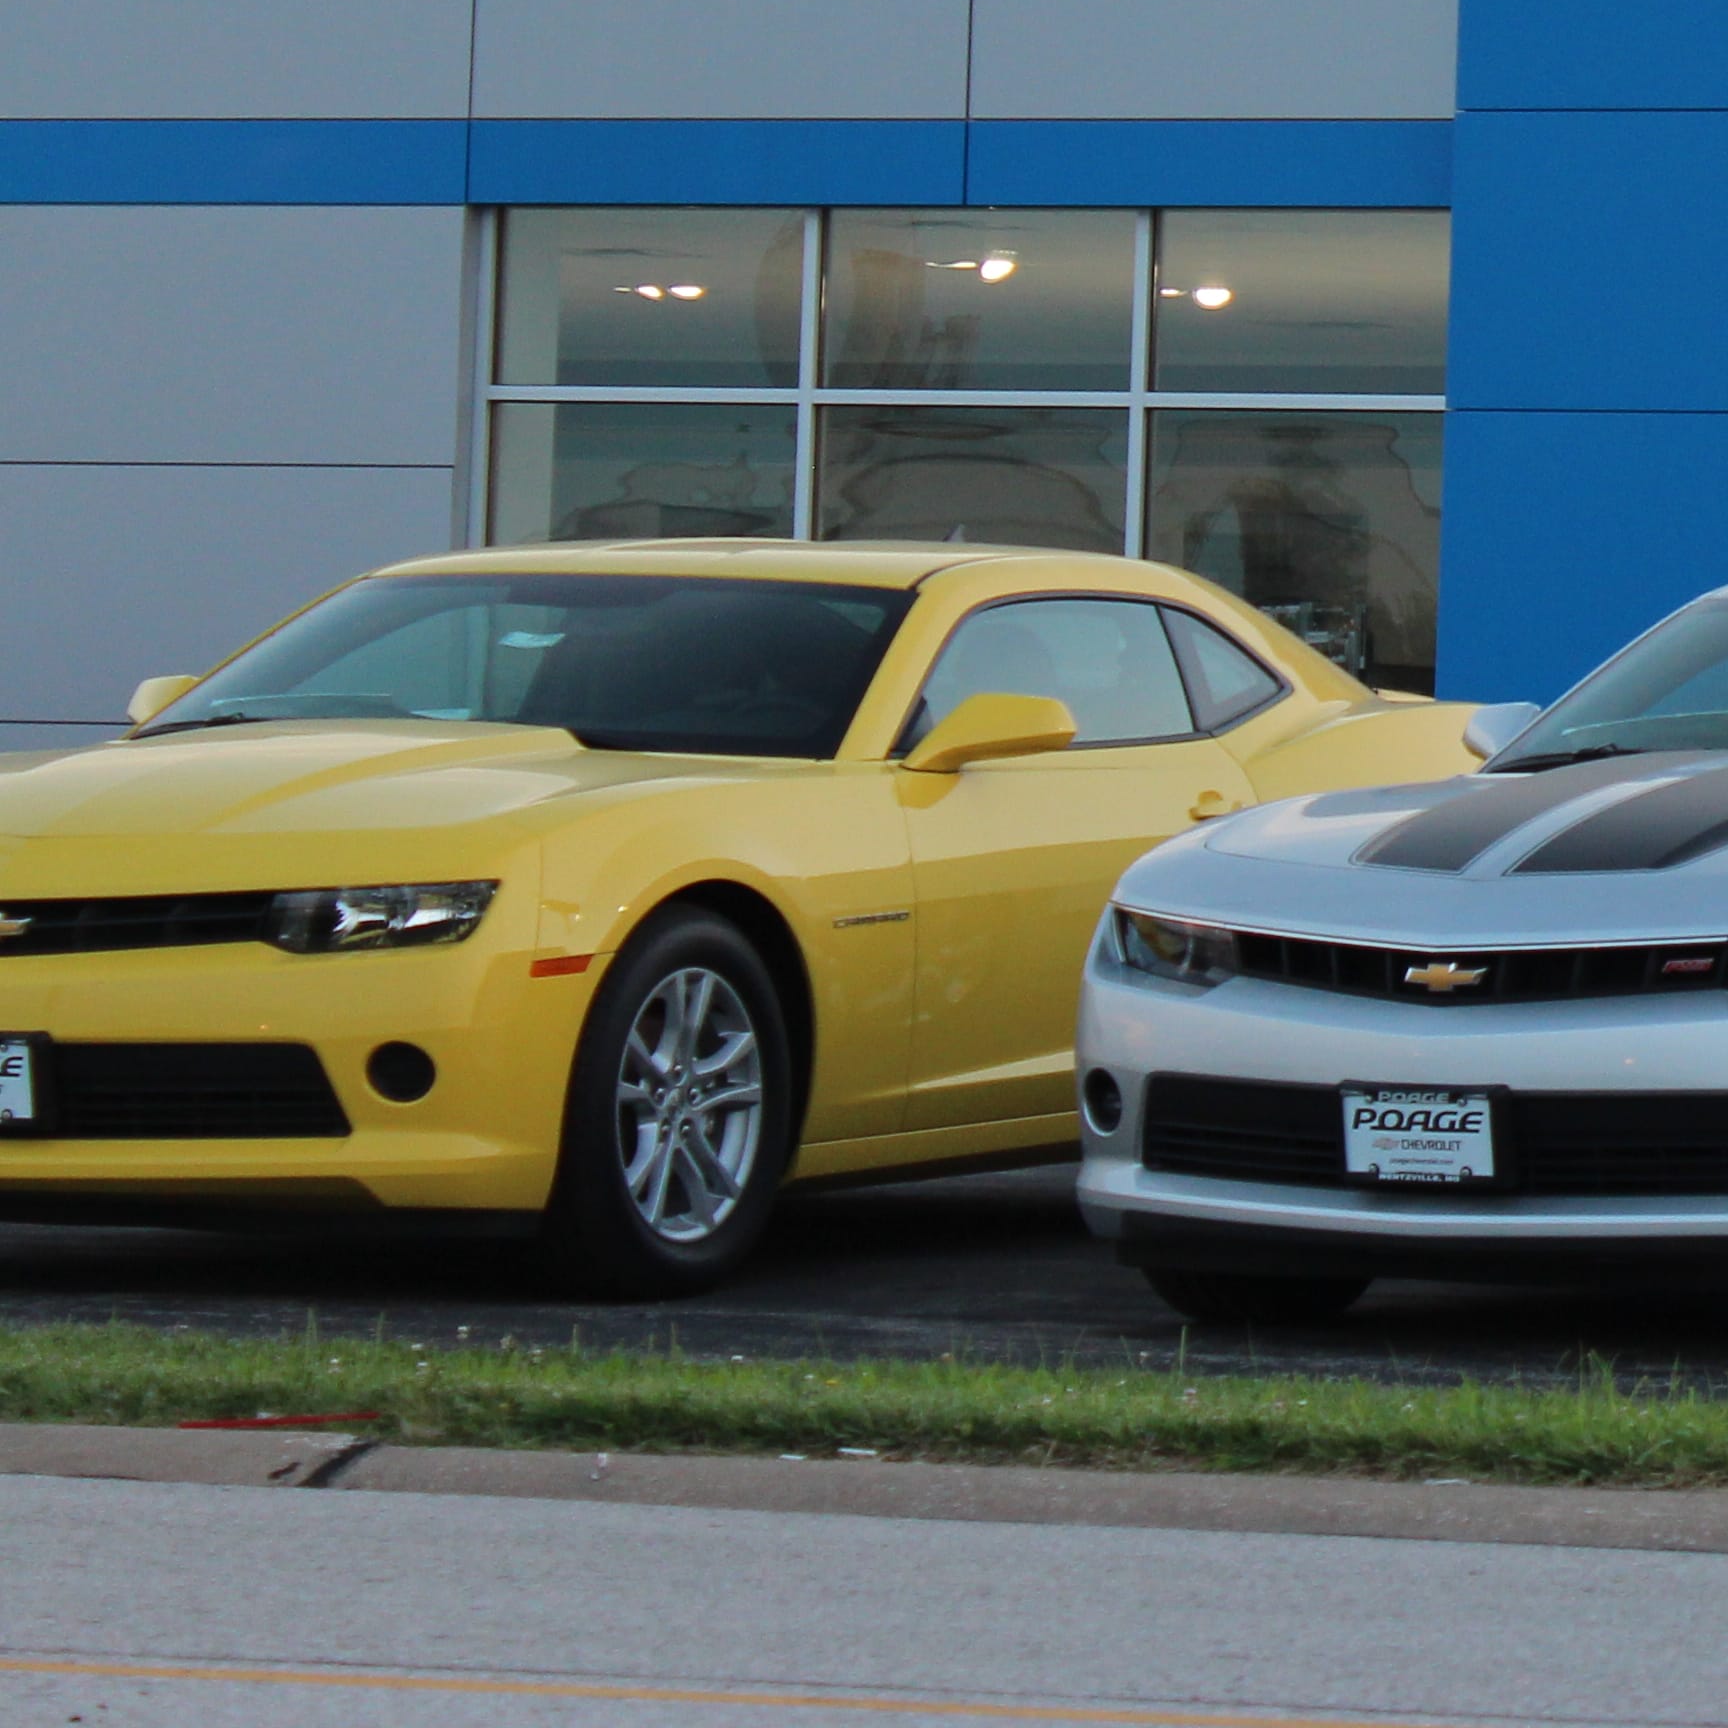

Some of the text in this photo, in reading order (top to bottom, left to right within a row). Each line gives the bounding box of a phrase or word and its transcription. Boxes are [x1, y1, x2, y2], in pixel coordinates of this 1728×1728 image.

[1377, 1090, 1450, 1104] POAGE
[1352, 1108, 1484, 1133] POAGE
[1401, 1139, 1462, 1152] CHEVROLET
